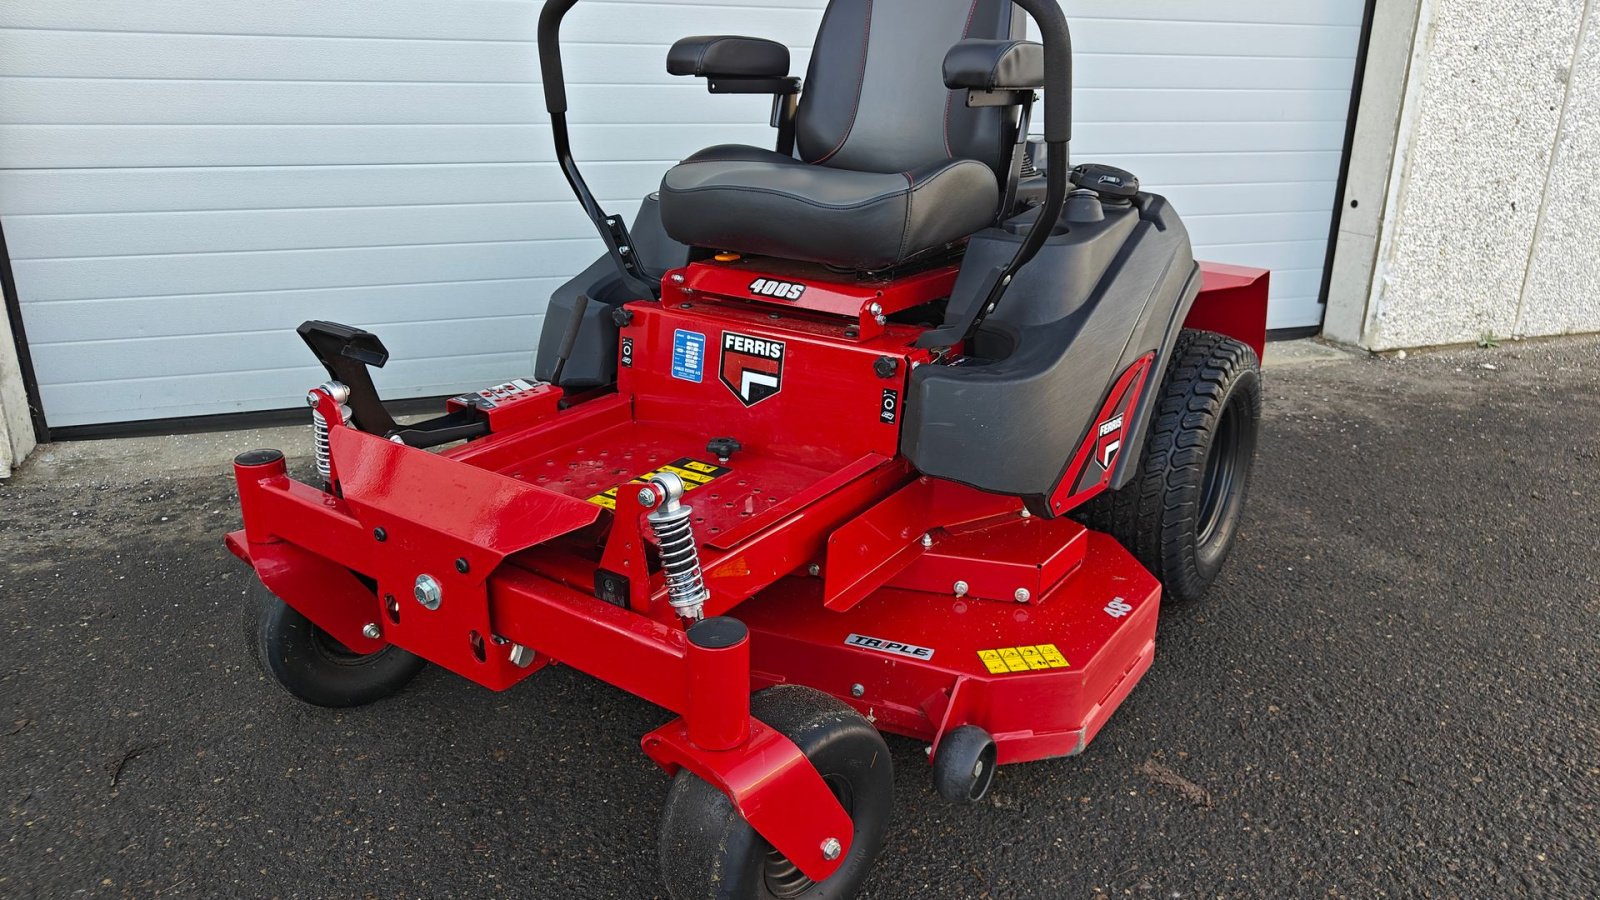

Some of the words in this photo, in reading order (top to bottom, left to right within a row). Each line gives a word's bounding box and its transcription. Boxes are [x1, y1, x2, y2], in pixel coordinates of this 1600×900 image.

[750, 278, 804, 299] 400S
[725, 335, 781, 358] FERRIS
[1100, 416, 1122, 436] FERRIS
[853, 636, 929, 656] TRIPLE
